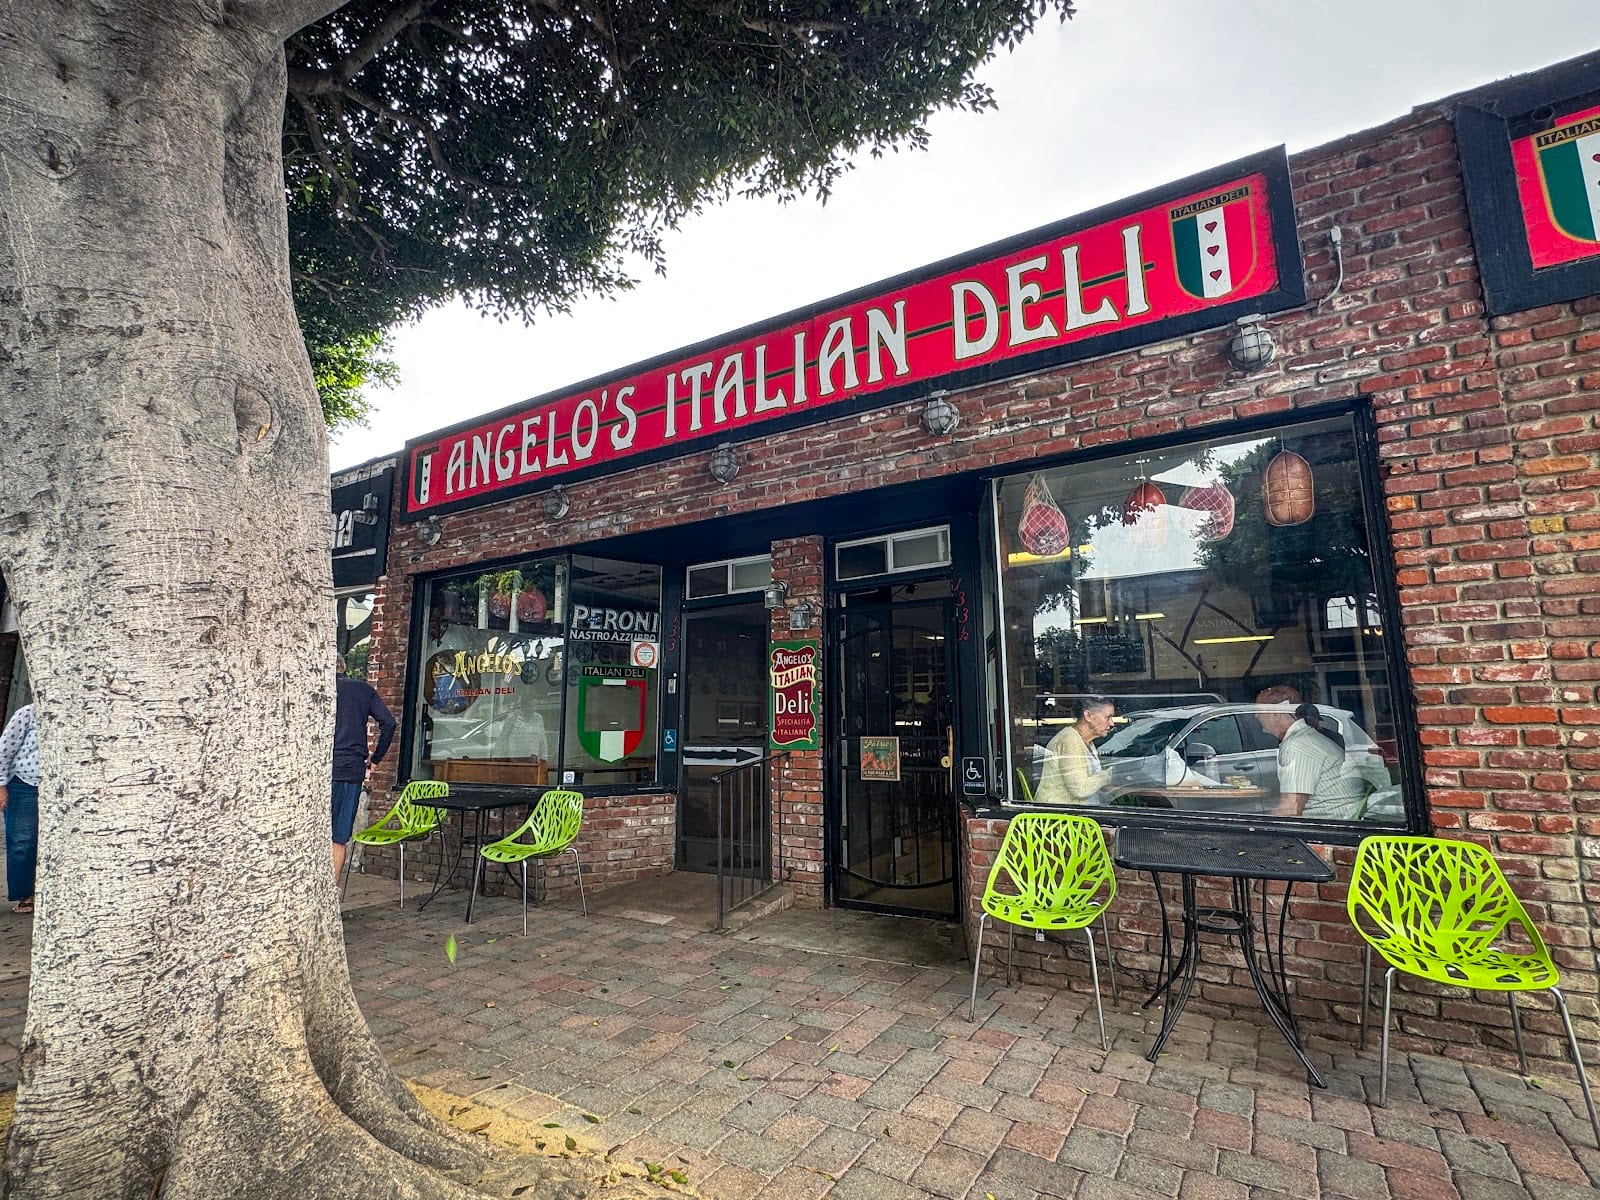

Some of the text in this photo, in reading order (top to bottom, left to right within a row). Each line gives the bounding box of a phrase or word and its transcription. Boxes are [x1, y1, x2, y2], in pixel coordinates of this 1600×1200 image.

[1541, 119, 1600, 146] ITALIAN
[1173, 188, 1246, 218] ITALIAN DELI
[444, 224, 1151, 495] ANGELO'S ITALIAN DELI
[570, 604, 659, 632] PERONI
[569, 629, 610, 641] NASTRO
[774, 652, 812, 669] ANGELO'S
[584, 666, 645, 678] ITALIAN DELI
[774, 666, 813, 686] ITALIAN
[455, 687, 515, 697] ITALIAN DELI
[775, 689, 809, 714] Deli
